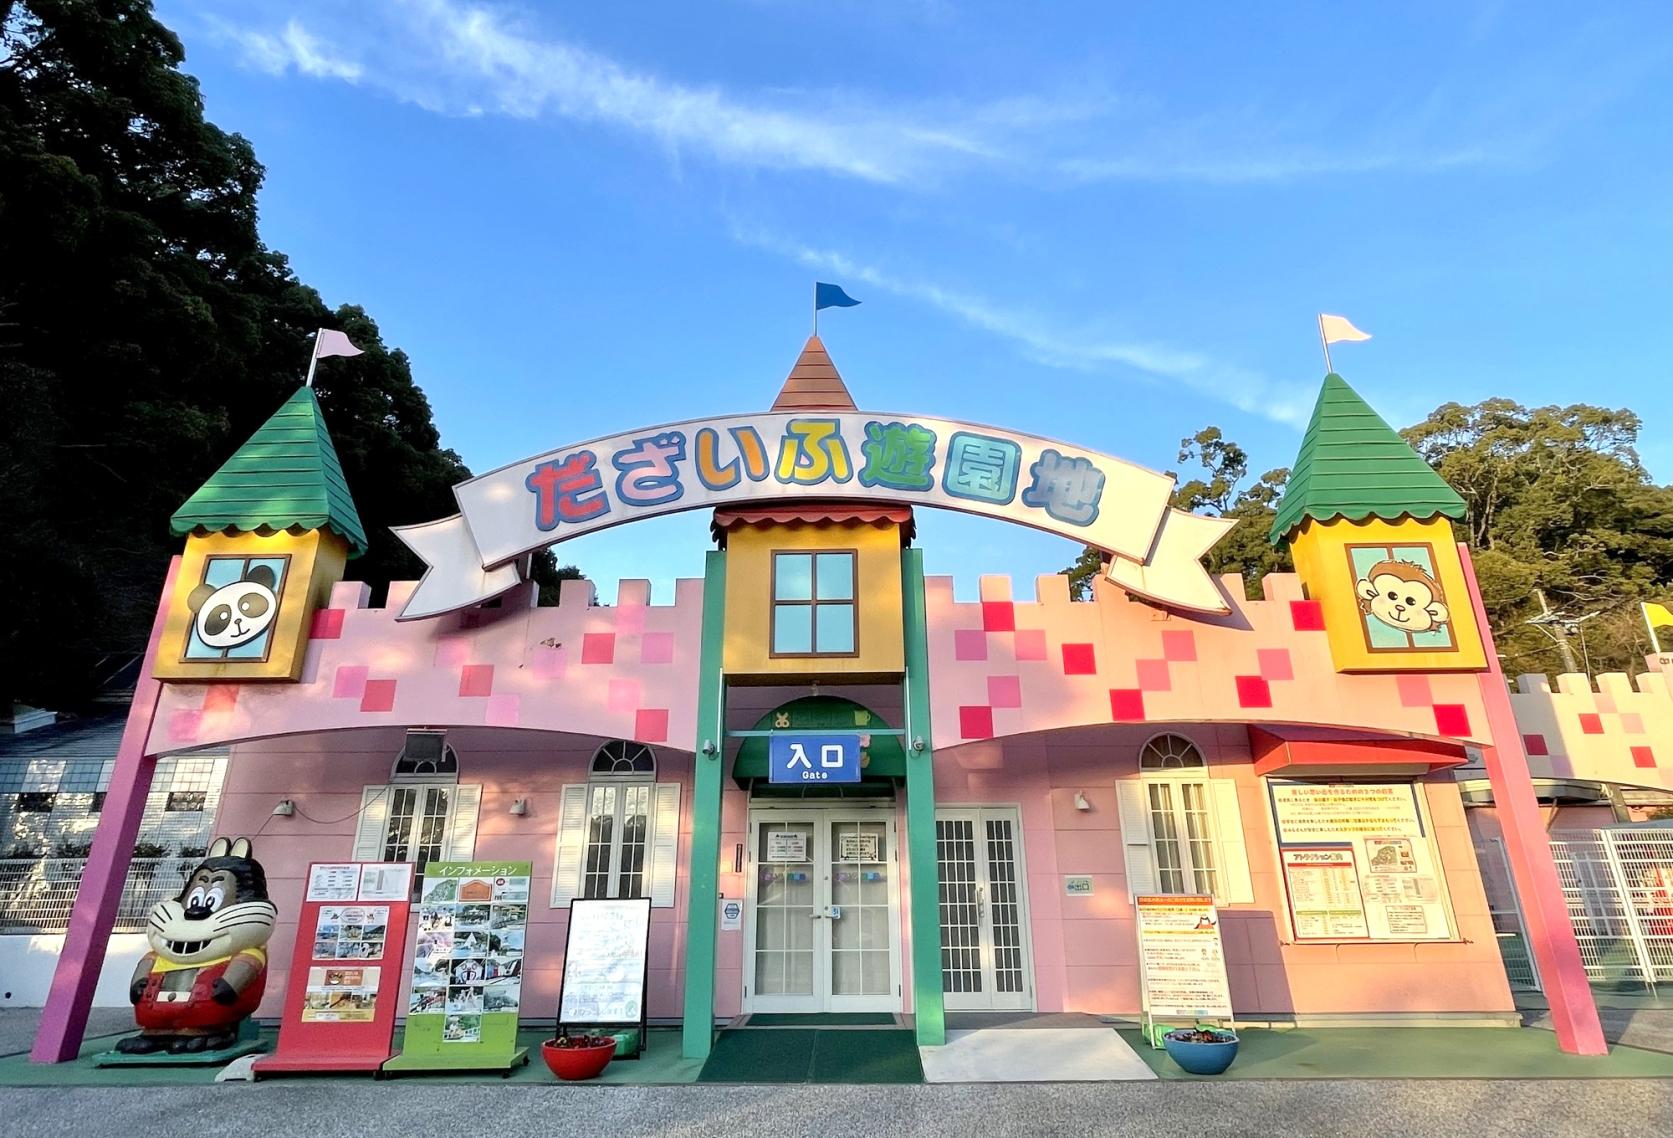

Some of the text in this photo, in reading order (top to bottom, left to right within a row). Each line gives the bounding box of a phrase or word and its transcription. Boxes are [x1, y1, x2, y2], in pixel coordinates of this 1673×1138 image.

[525, 418, 1106, 531] だざいふ遊園地
[786, 744, 843, 769] 入口
[802, 771, 828, 780] Gate
[439, 866, 517, 876] インフォメーション
